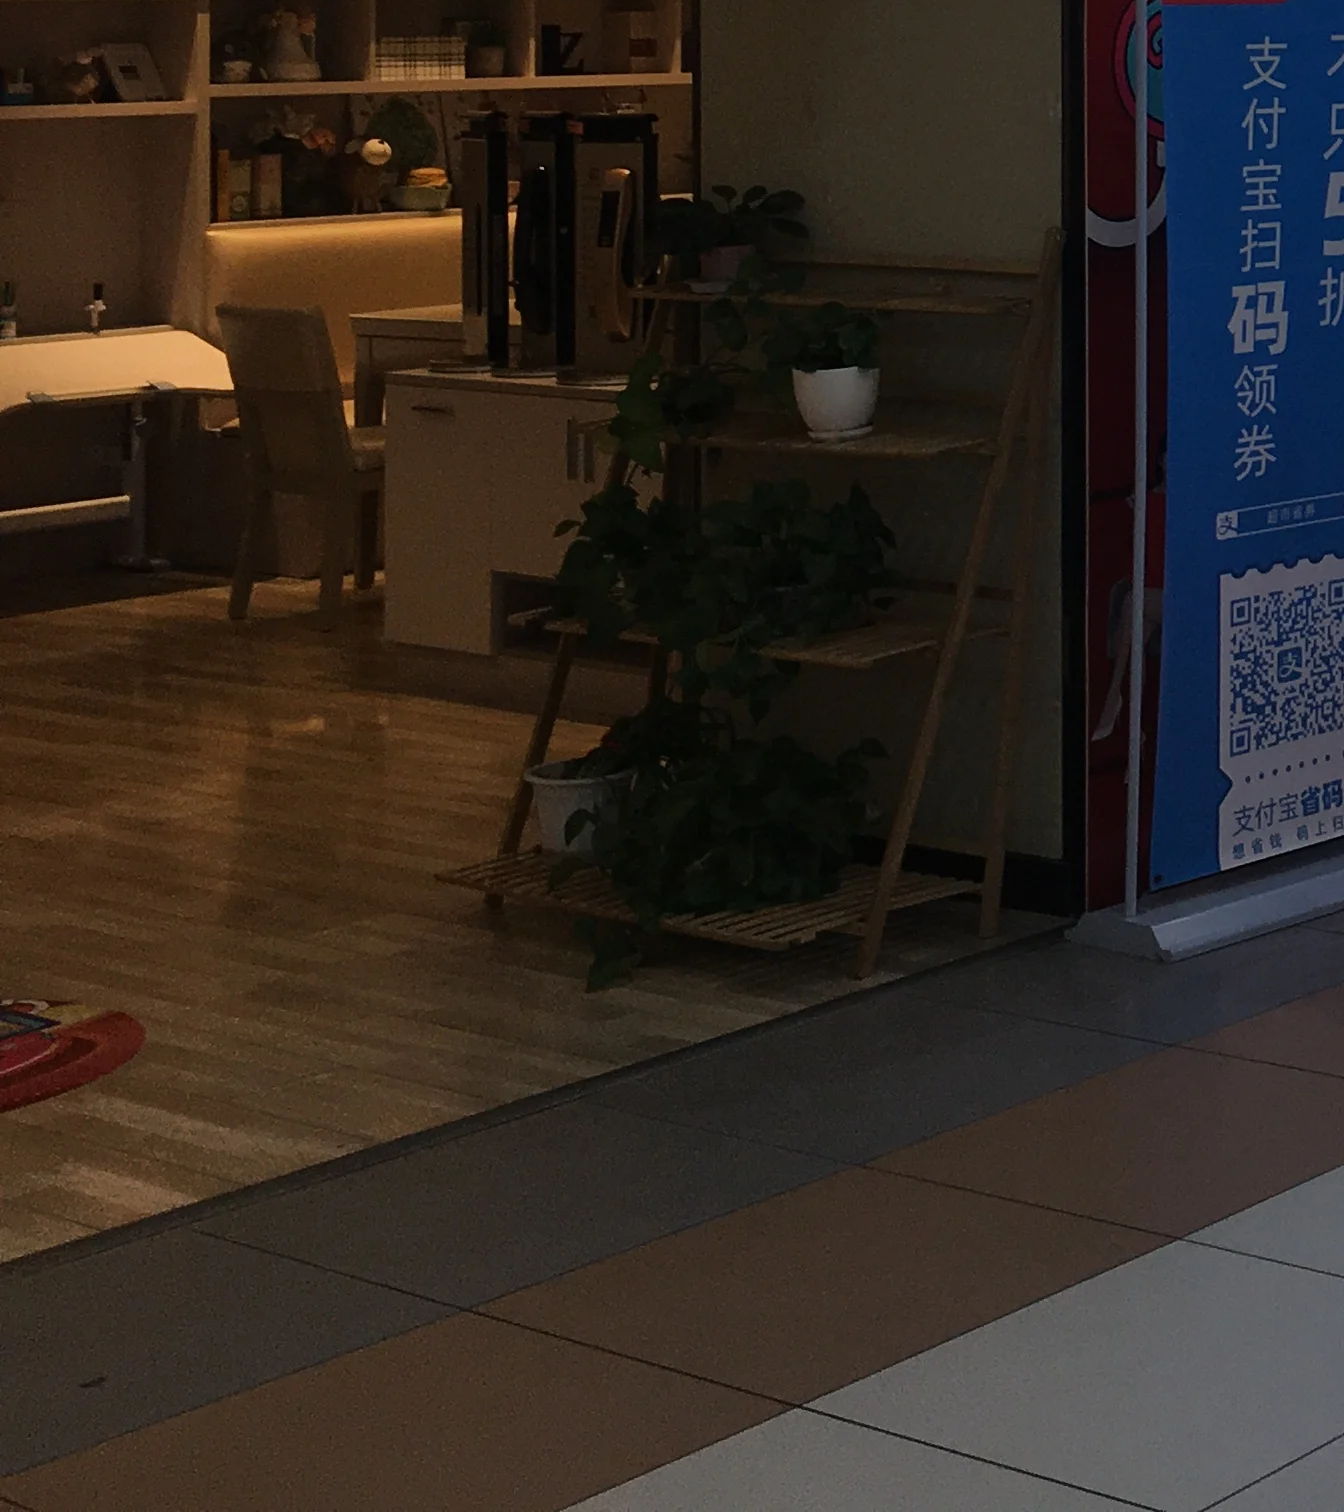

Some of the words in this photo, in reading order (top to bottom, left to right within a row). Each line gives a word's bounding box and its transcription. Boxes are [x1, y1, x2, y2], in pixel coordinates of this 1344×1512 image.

[1228, 36, 1289, 483] 支付宝扫码领券
[1232, 778, 1343, 837] 支付宝省码
